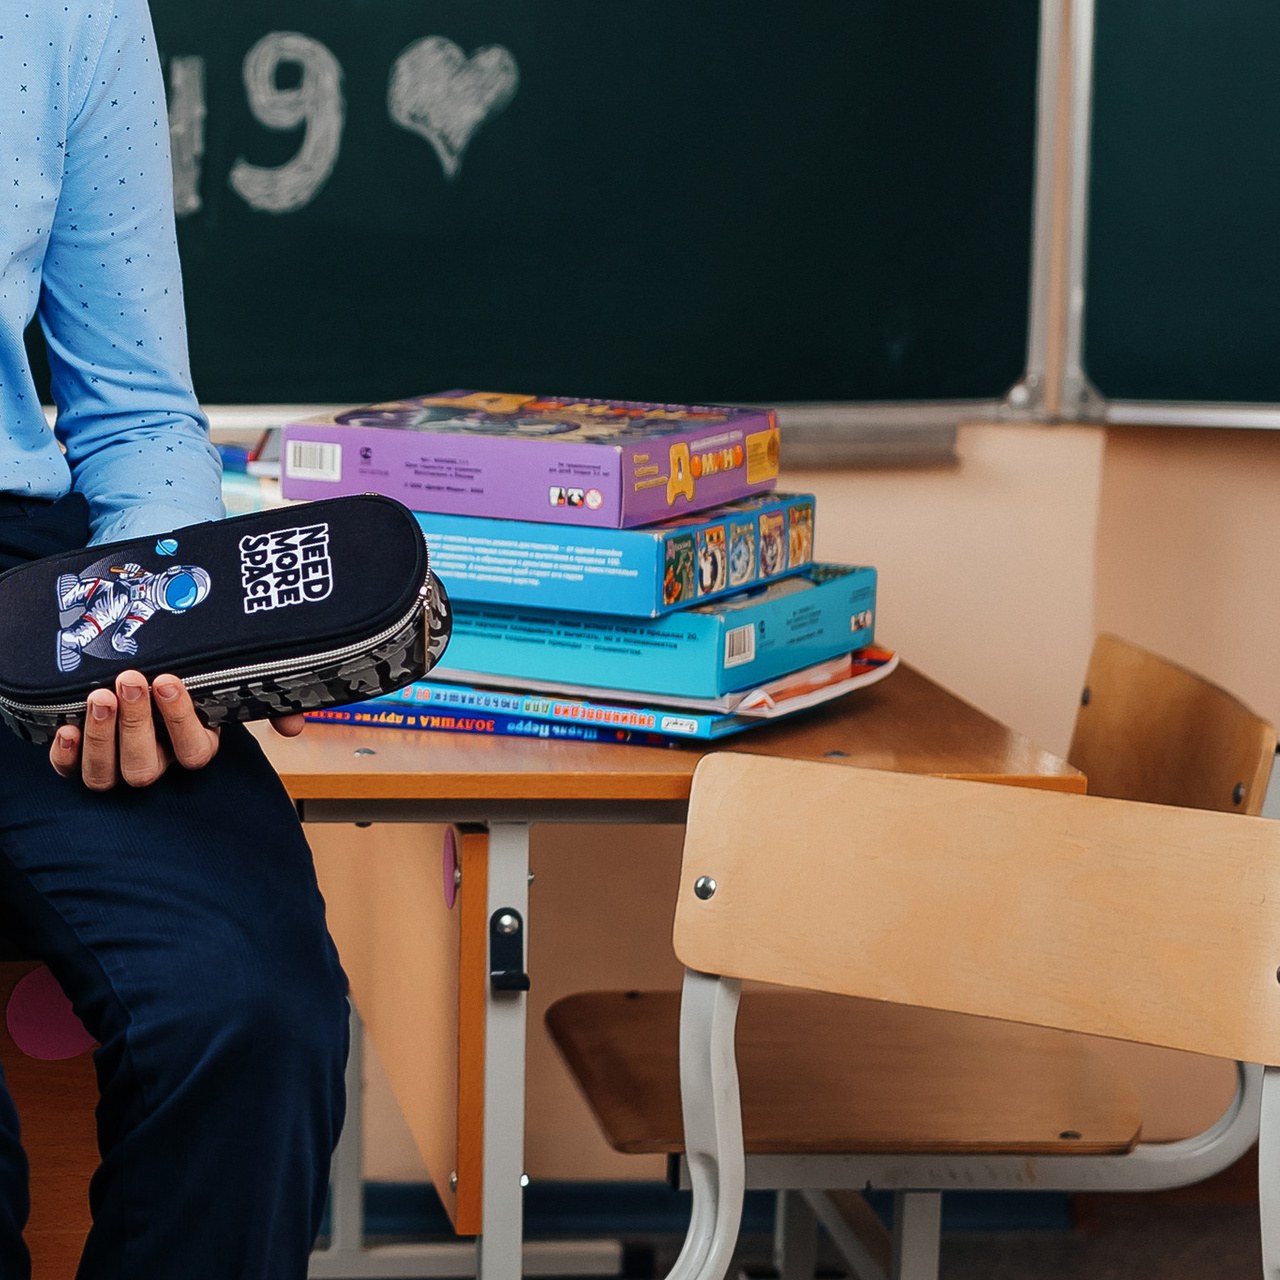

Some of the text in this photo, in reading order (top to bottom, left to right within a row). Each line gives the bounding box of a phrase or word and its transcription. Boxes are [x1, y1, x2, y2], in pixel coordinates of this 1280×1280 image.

[238, 533, 275, 614] SPACE
[269, 527, 302, 608] MORE
[299, 523, 334, 603] NEED
[354, 711, 405, 725] другие
[419, 714, 495, 732] ЗОЛУШКА
[507, 720, 550, 738] Перро
